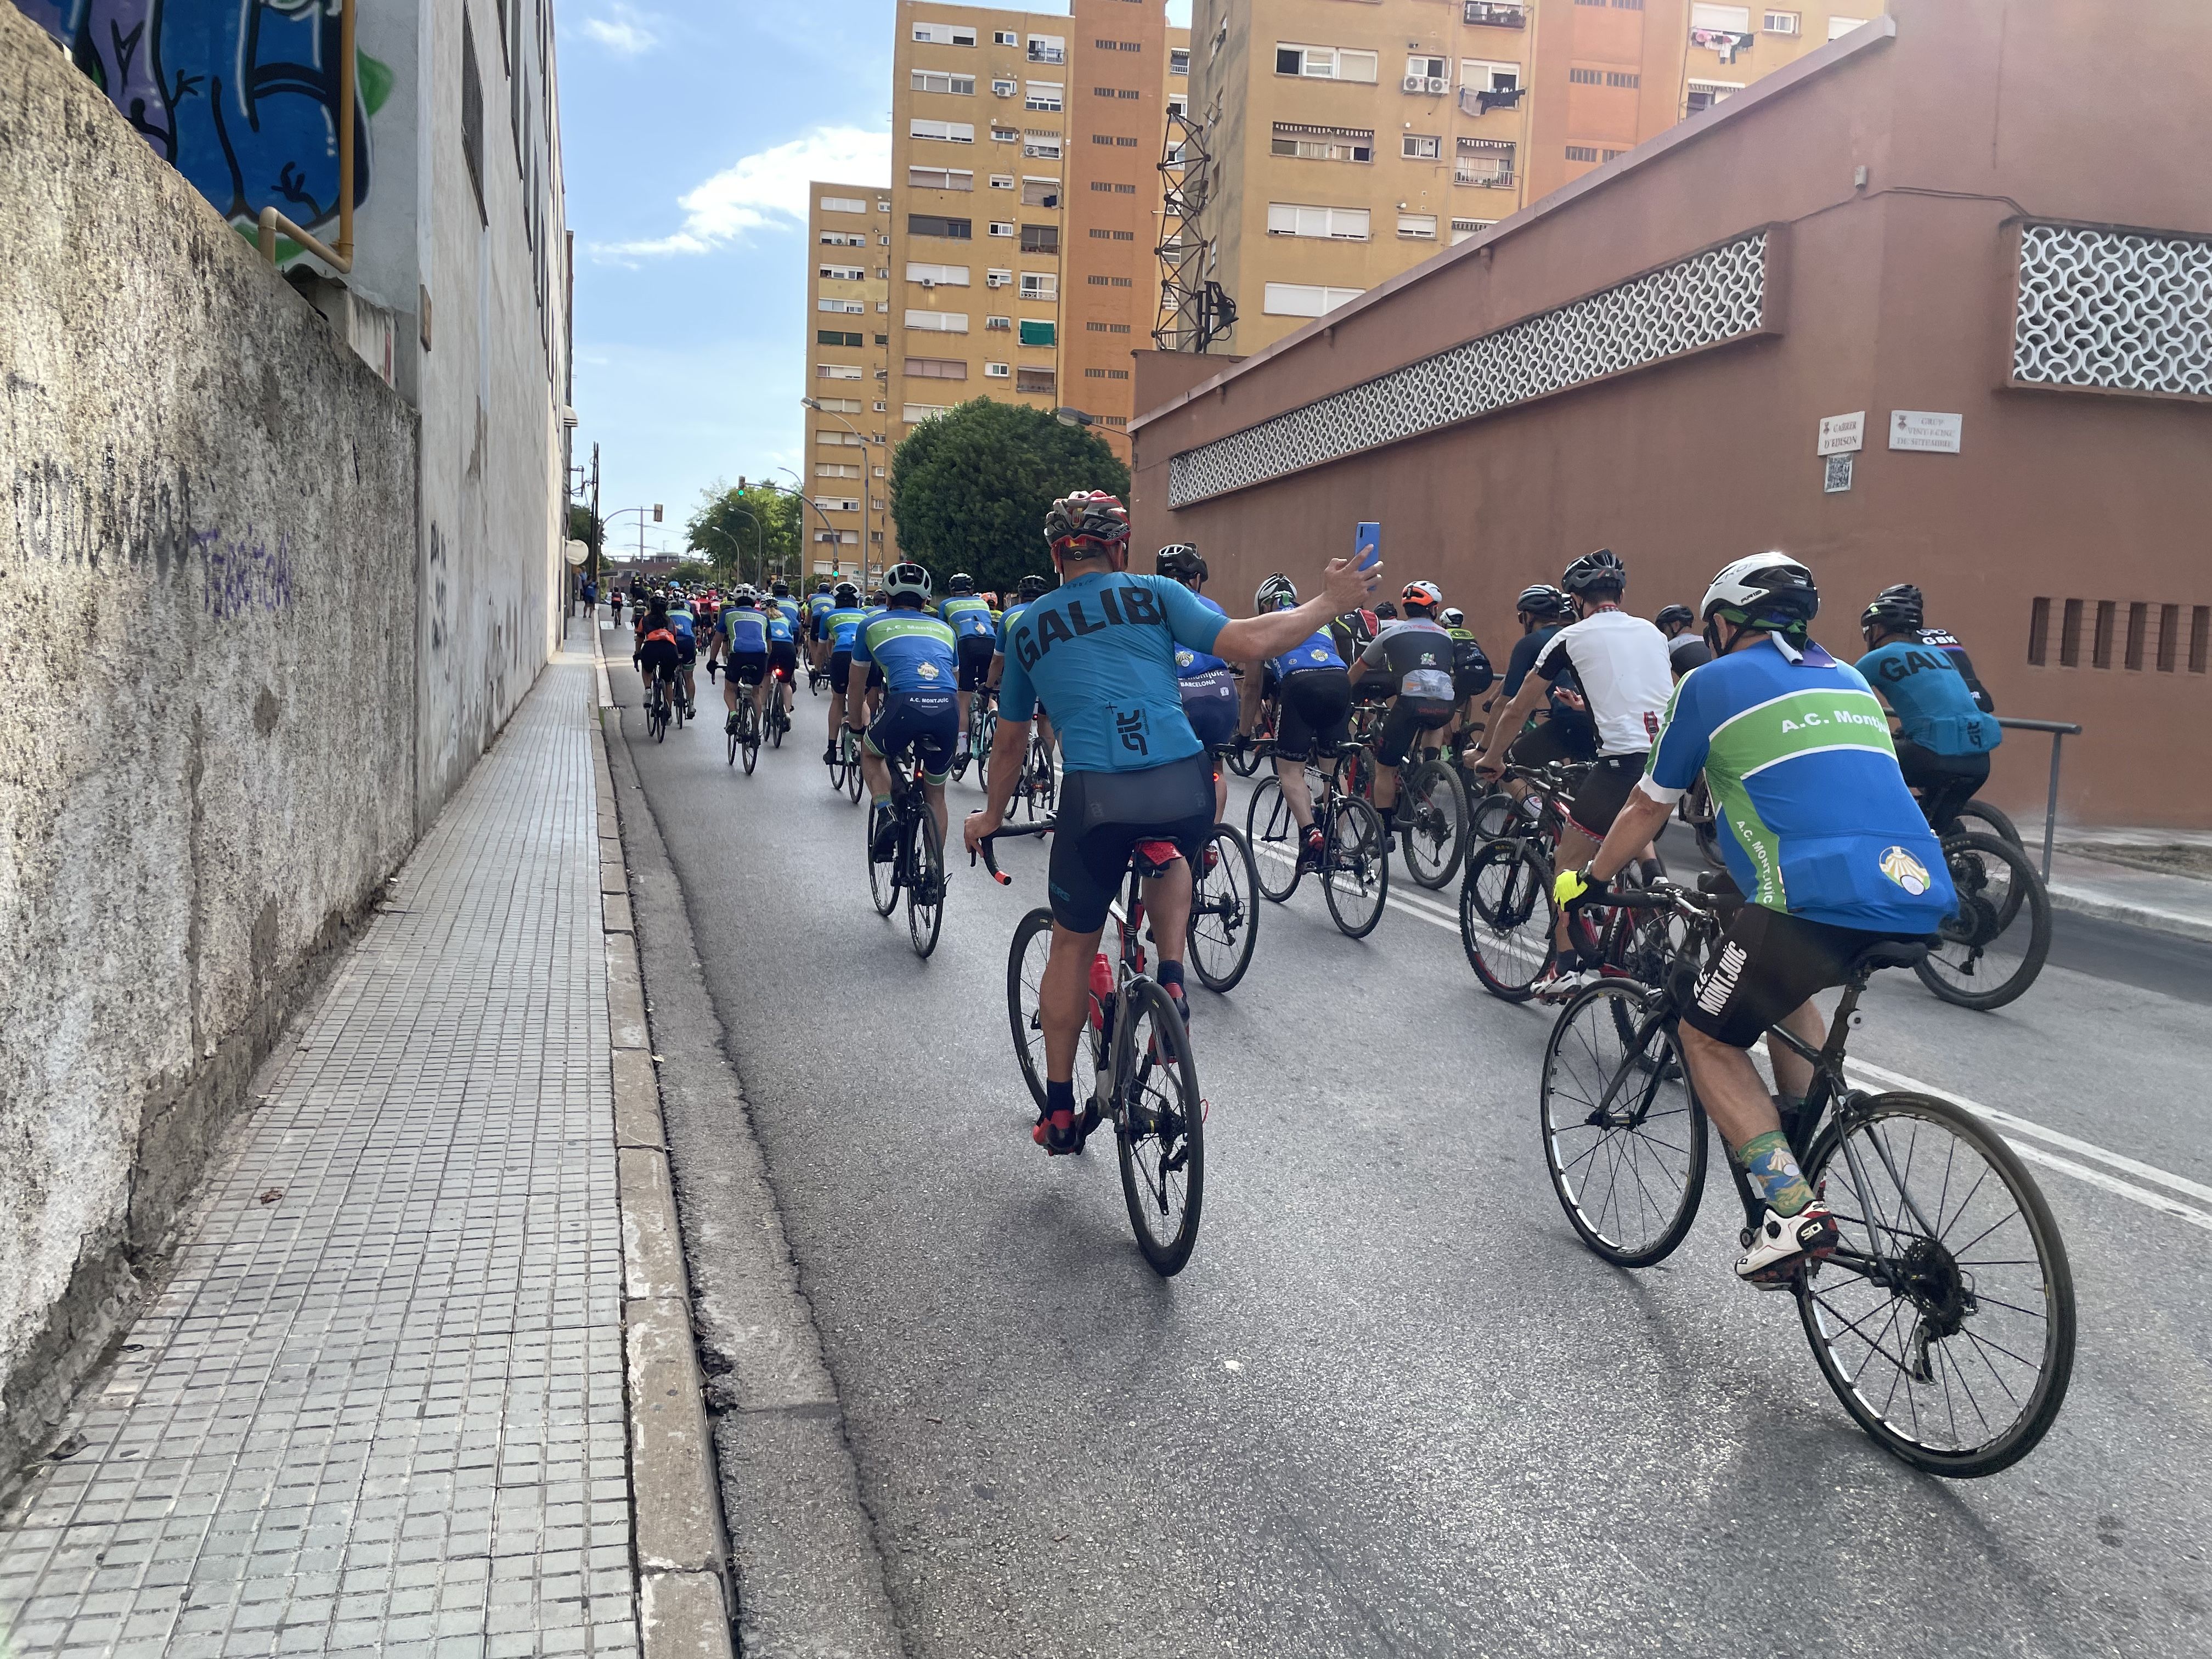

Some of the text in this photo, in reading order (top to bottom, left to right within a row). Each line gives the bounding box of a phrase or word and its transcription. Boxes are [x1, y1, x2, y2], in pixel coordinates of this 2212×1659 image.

[1180, 679, 1216, 687] BARCELONA
[1782, 713, 1830, 734] A.C.
[1736, 820, 1753, 842] A.C.
[1694, 940, 1747, 1016] A.C. MONTJUÏC
